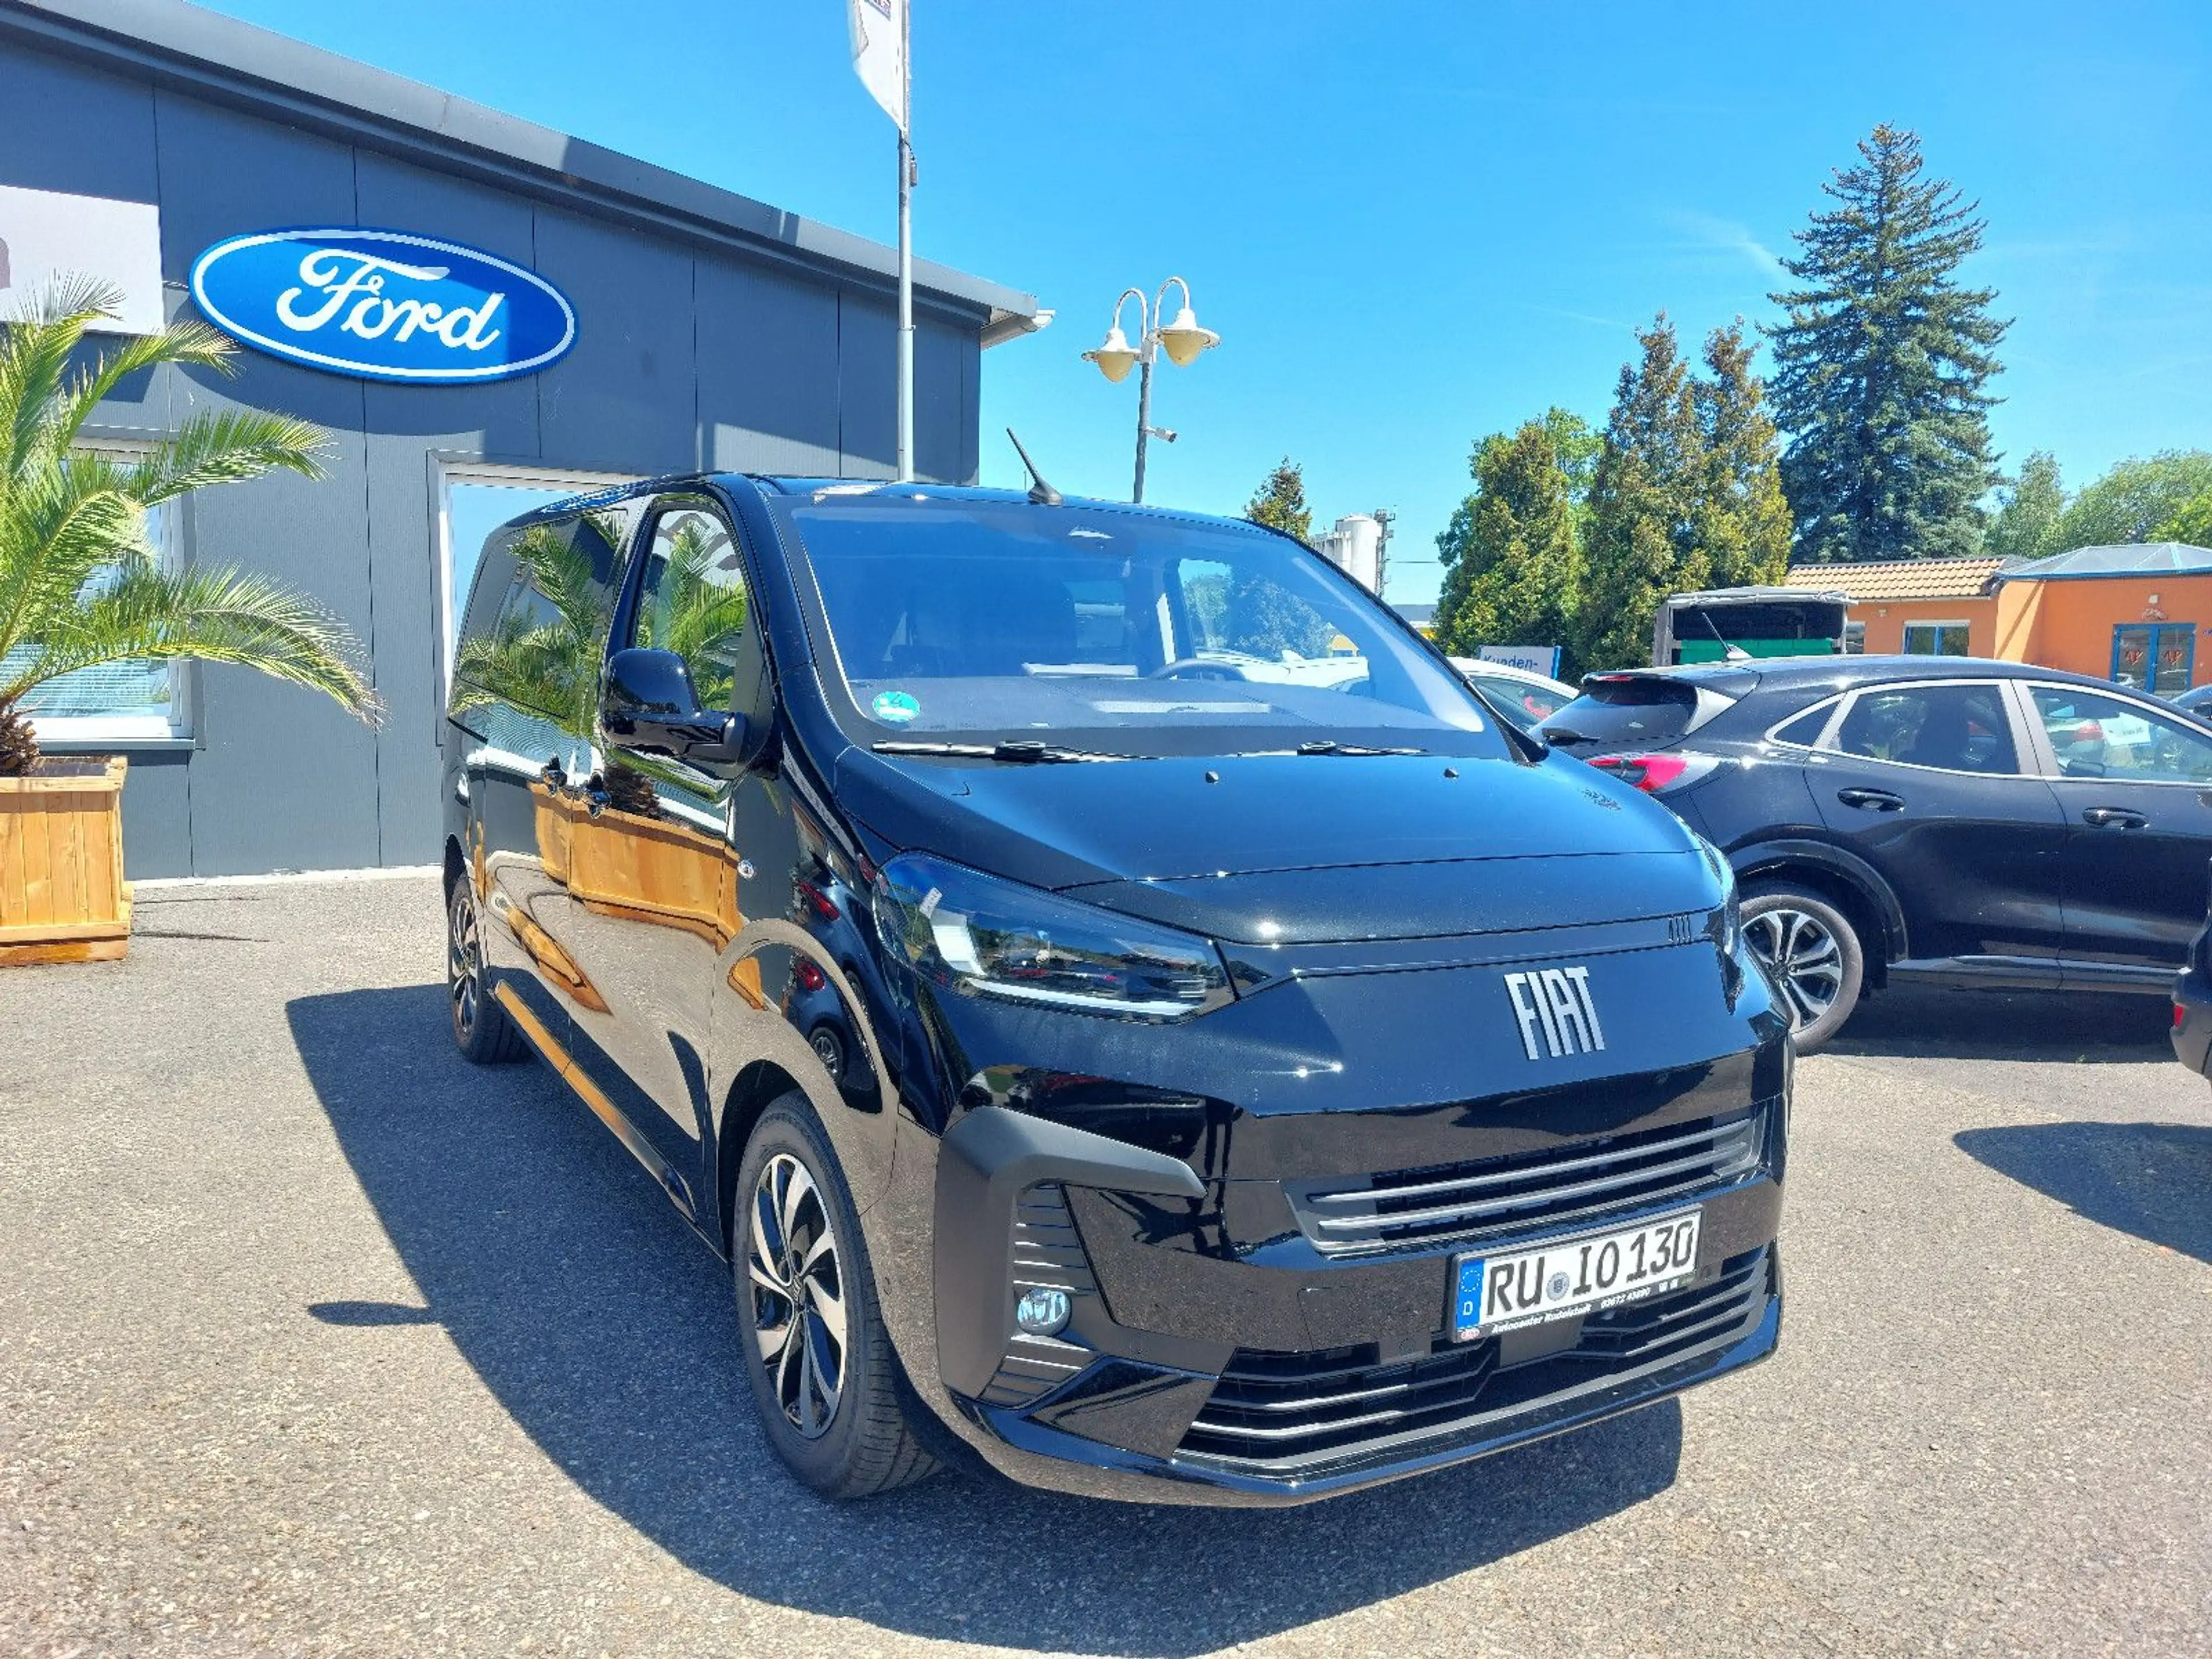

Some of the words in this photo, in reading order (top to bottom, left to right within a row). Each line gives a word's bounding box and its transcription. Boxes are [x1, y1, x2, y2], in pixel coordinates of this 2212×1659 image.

[276, 248, 505, 350] Ford
[1503, 966, 1605, 1060] FIAT
[1463, 1300, 1474, 1316] D
[1486, 1256, 1545, 1317] RU
[1626, 1219, 1694, 1283] 130
